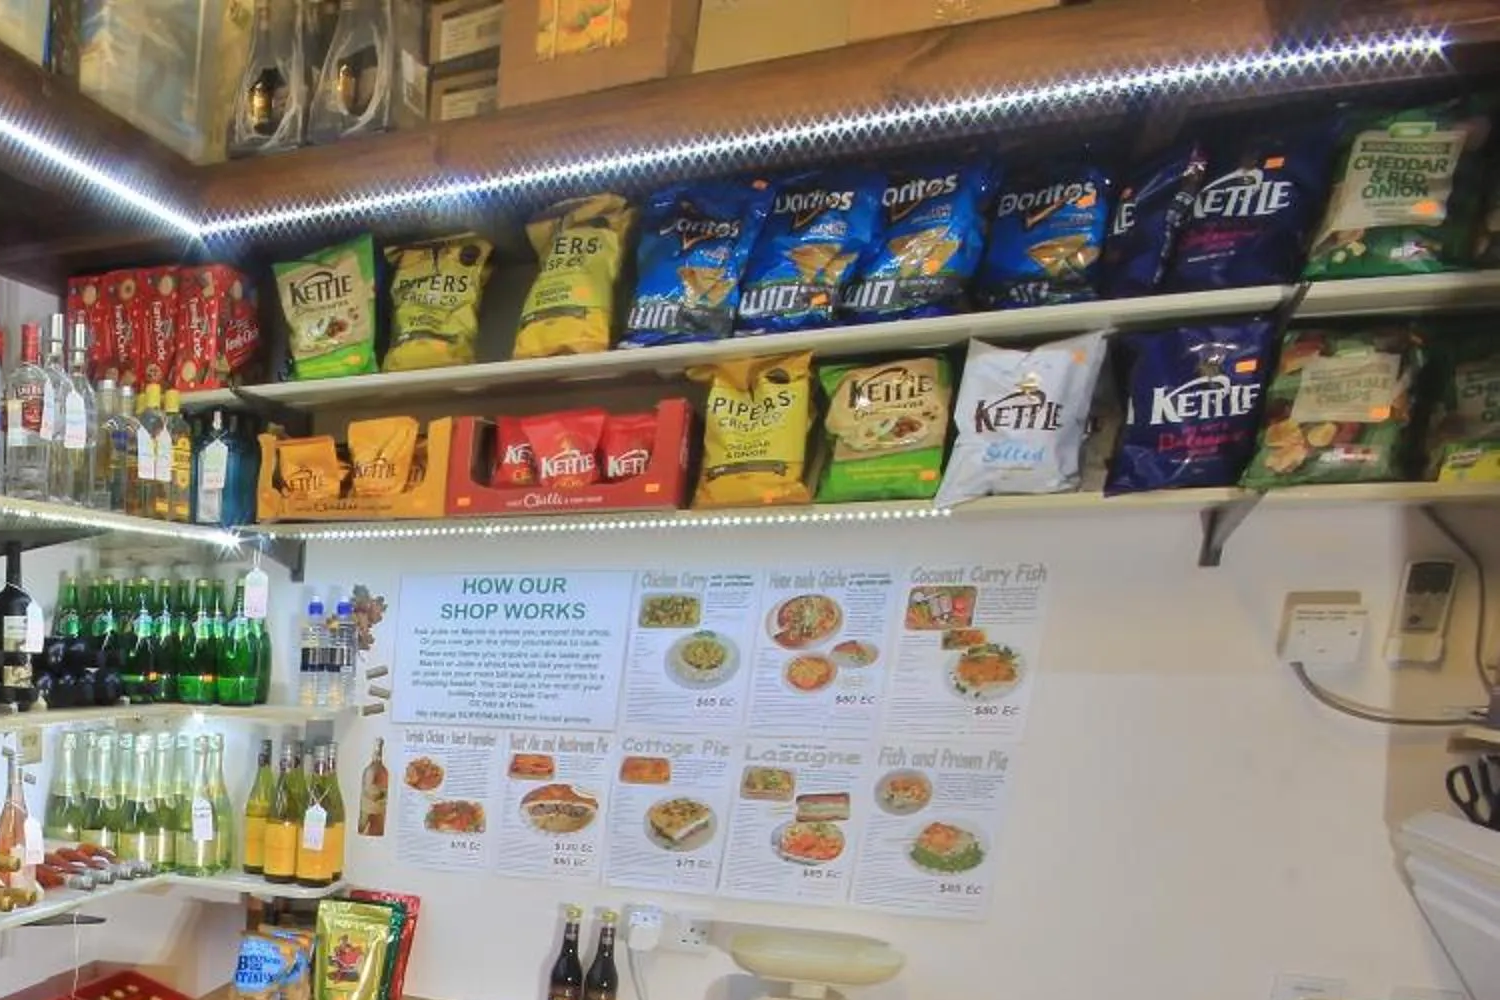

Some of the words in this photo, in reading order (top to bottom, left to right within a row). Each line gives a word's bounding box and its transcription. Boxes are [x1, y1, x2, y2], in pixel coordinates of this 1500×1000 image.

[1352, 154, 1449, 174] CHEDDAR
[881, 173, 959, 208] oritos
[1361, 182, 1429, 200] ONION
[1385, 170, 1427, 187] RED
[774, 189, 855, 214] Doritos
[997, 181, 1097, 217] Doritos
[553, 236, 600, 256] ERS
[289, 272, 353, 307] KETTLE
[848, 368, 933, 409] KETTLE
[1150, 376, 1261, 425] KETTLE
[712, 390, 793, 422] PIPERS
[974, 390, 1064, 433] KETTLE
[540, 450, 596, 480] KETTLE
[607, 450, 650, 479] KETT
[1016, 563, 1048, 582] Fish
[462, 577, 513, 594] HOW
[519, 577, 567, 594] OUR
[441, 603, 498, 620] SHOP
[504, 602, 586, 620] WORKS
[621, 737, 694, 758] Cottage
[702, 740, 732, 757] Pie
[745, 743, 862, 768] Lasagne
[877, 746, 908, 767] Fish
[911, 747, 938, 768] and
